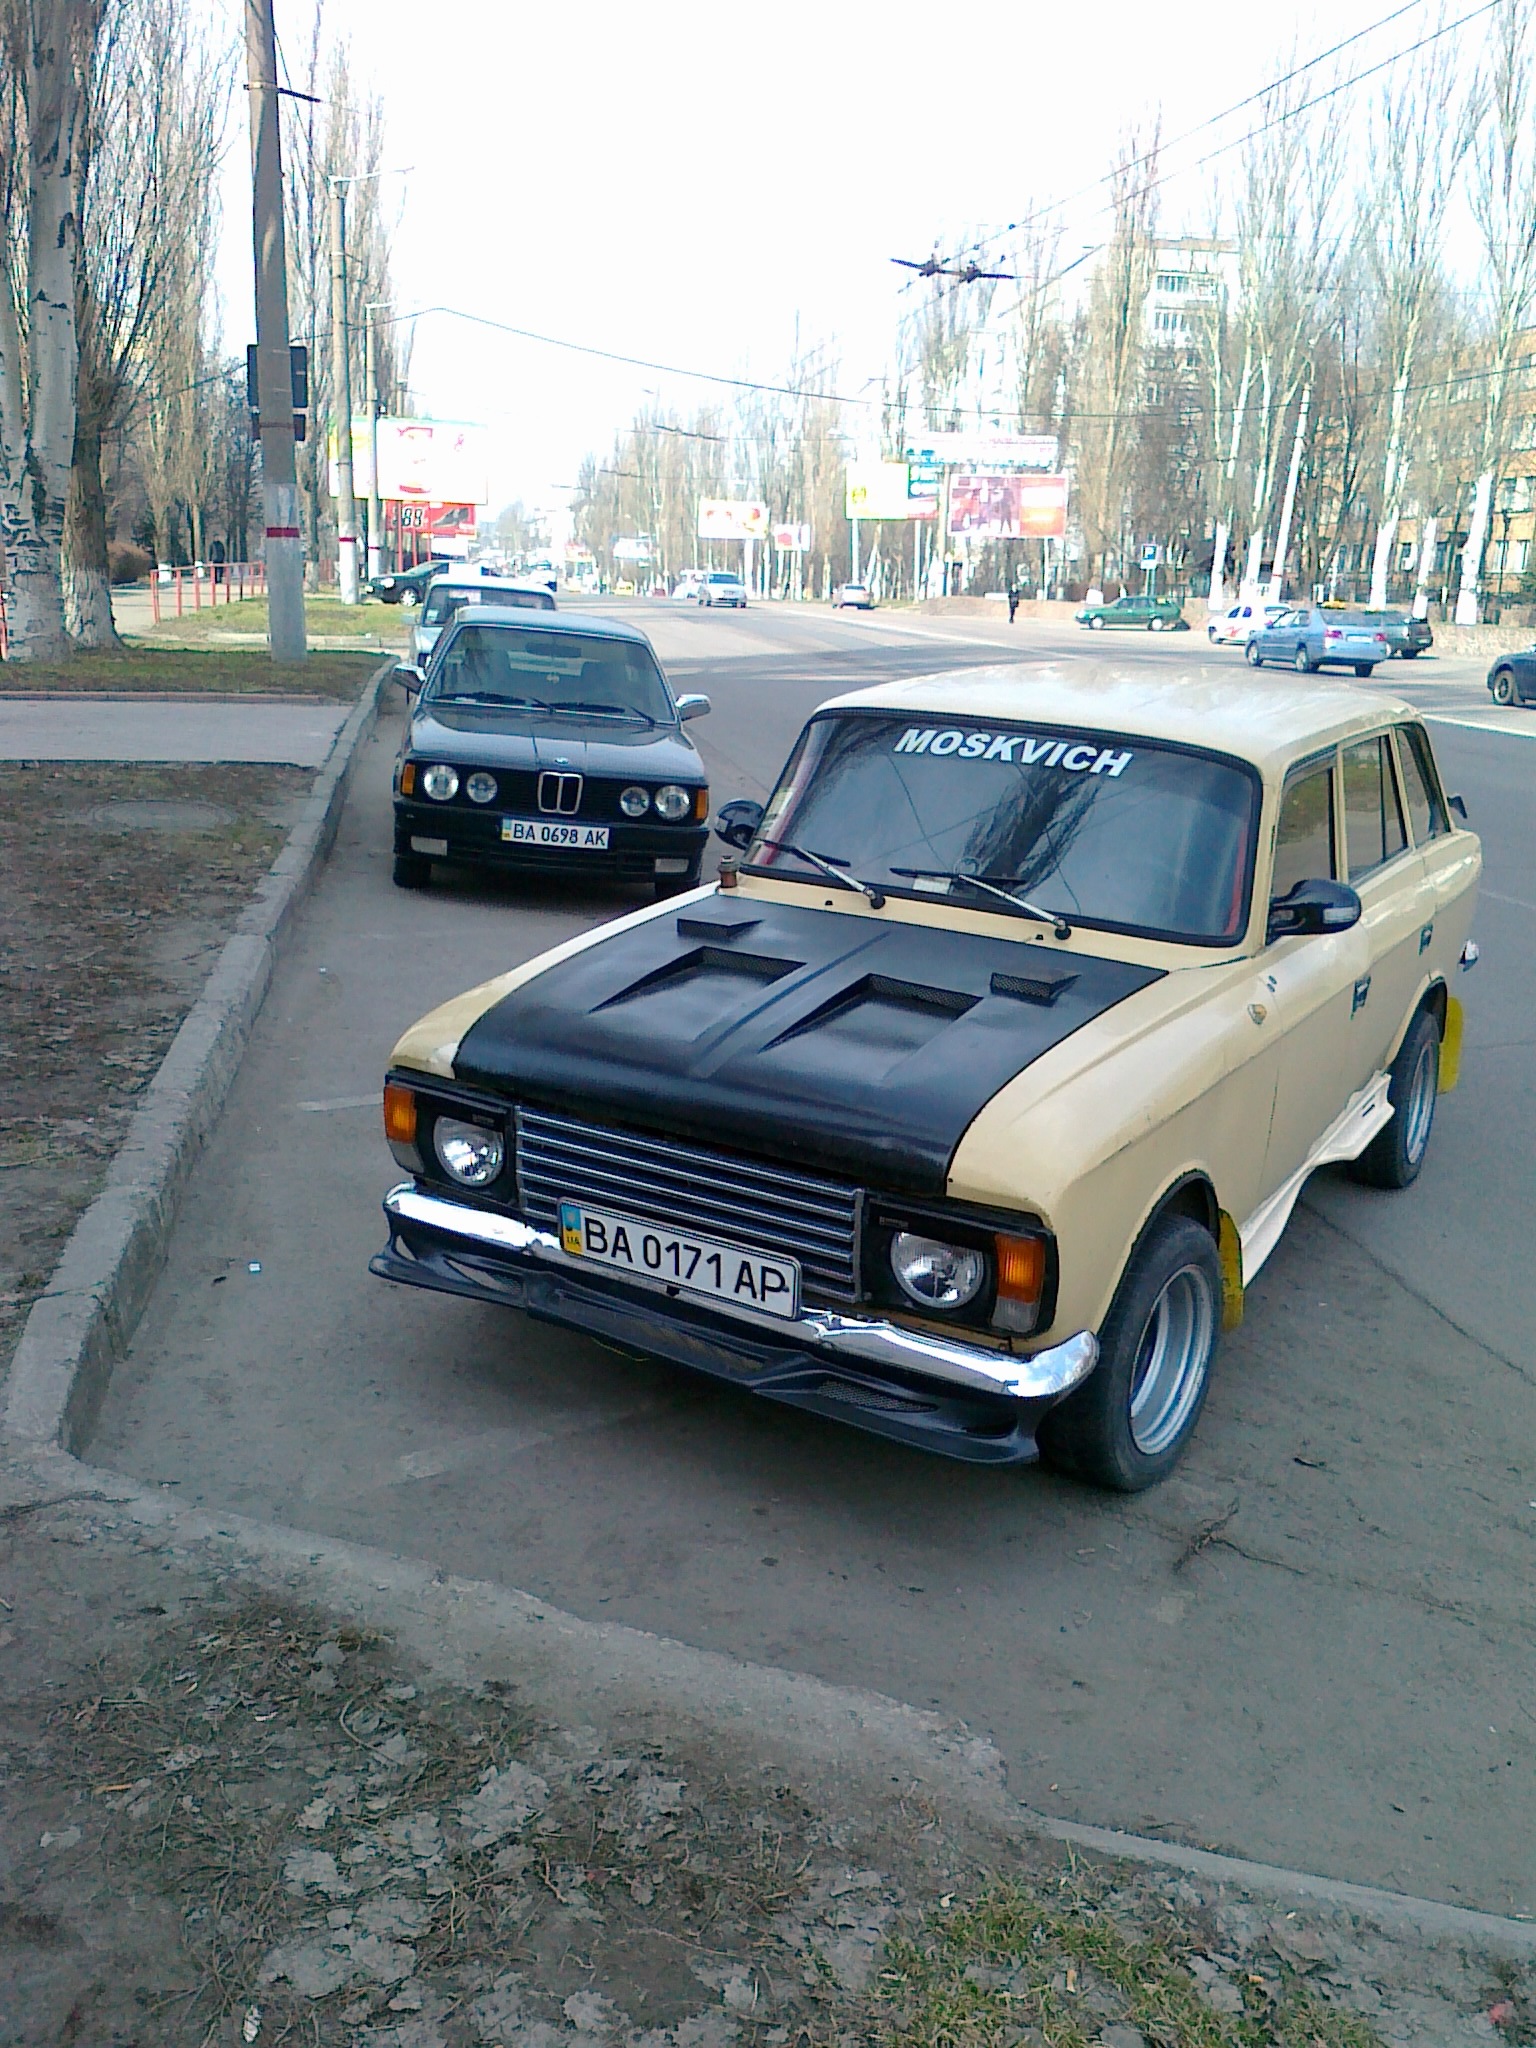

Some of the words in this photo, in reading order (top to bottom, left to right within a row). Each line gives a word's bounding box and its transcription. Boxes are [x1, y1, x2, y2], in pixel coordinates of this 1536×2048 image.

[894, 728, 1133, 777] MOSKVICH
[513, 823, 536, 841] BA
[541, 826, 578, 844] 0698
[584, 829, 606, 846] AK
[584, 1216, 633, 1263] BA
[642, 1234, 722, 1288] 0171
[734, 1260, 787, 1302] AP
